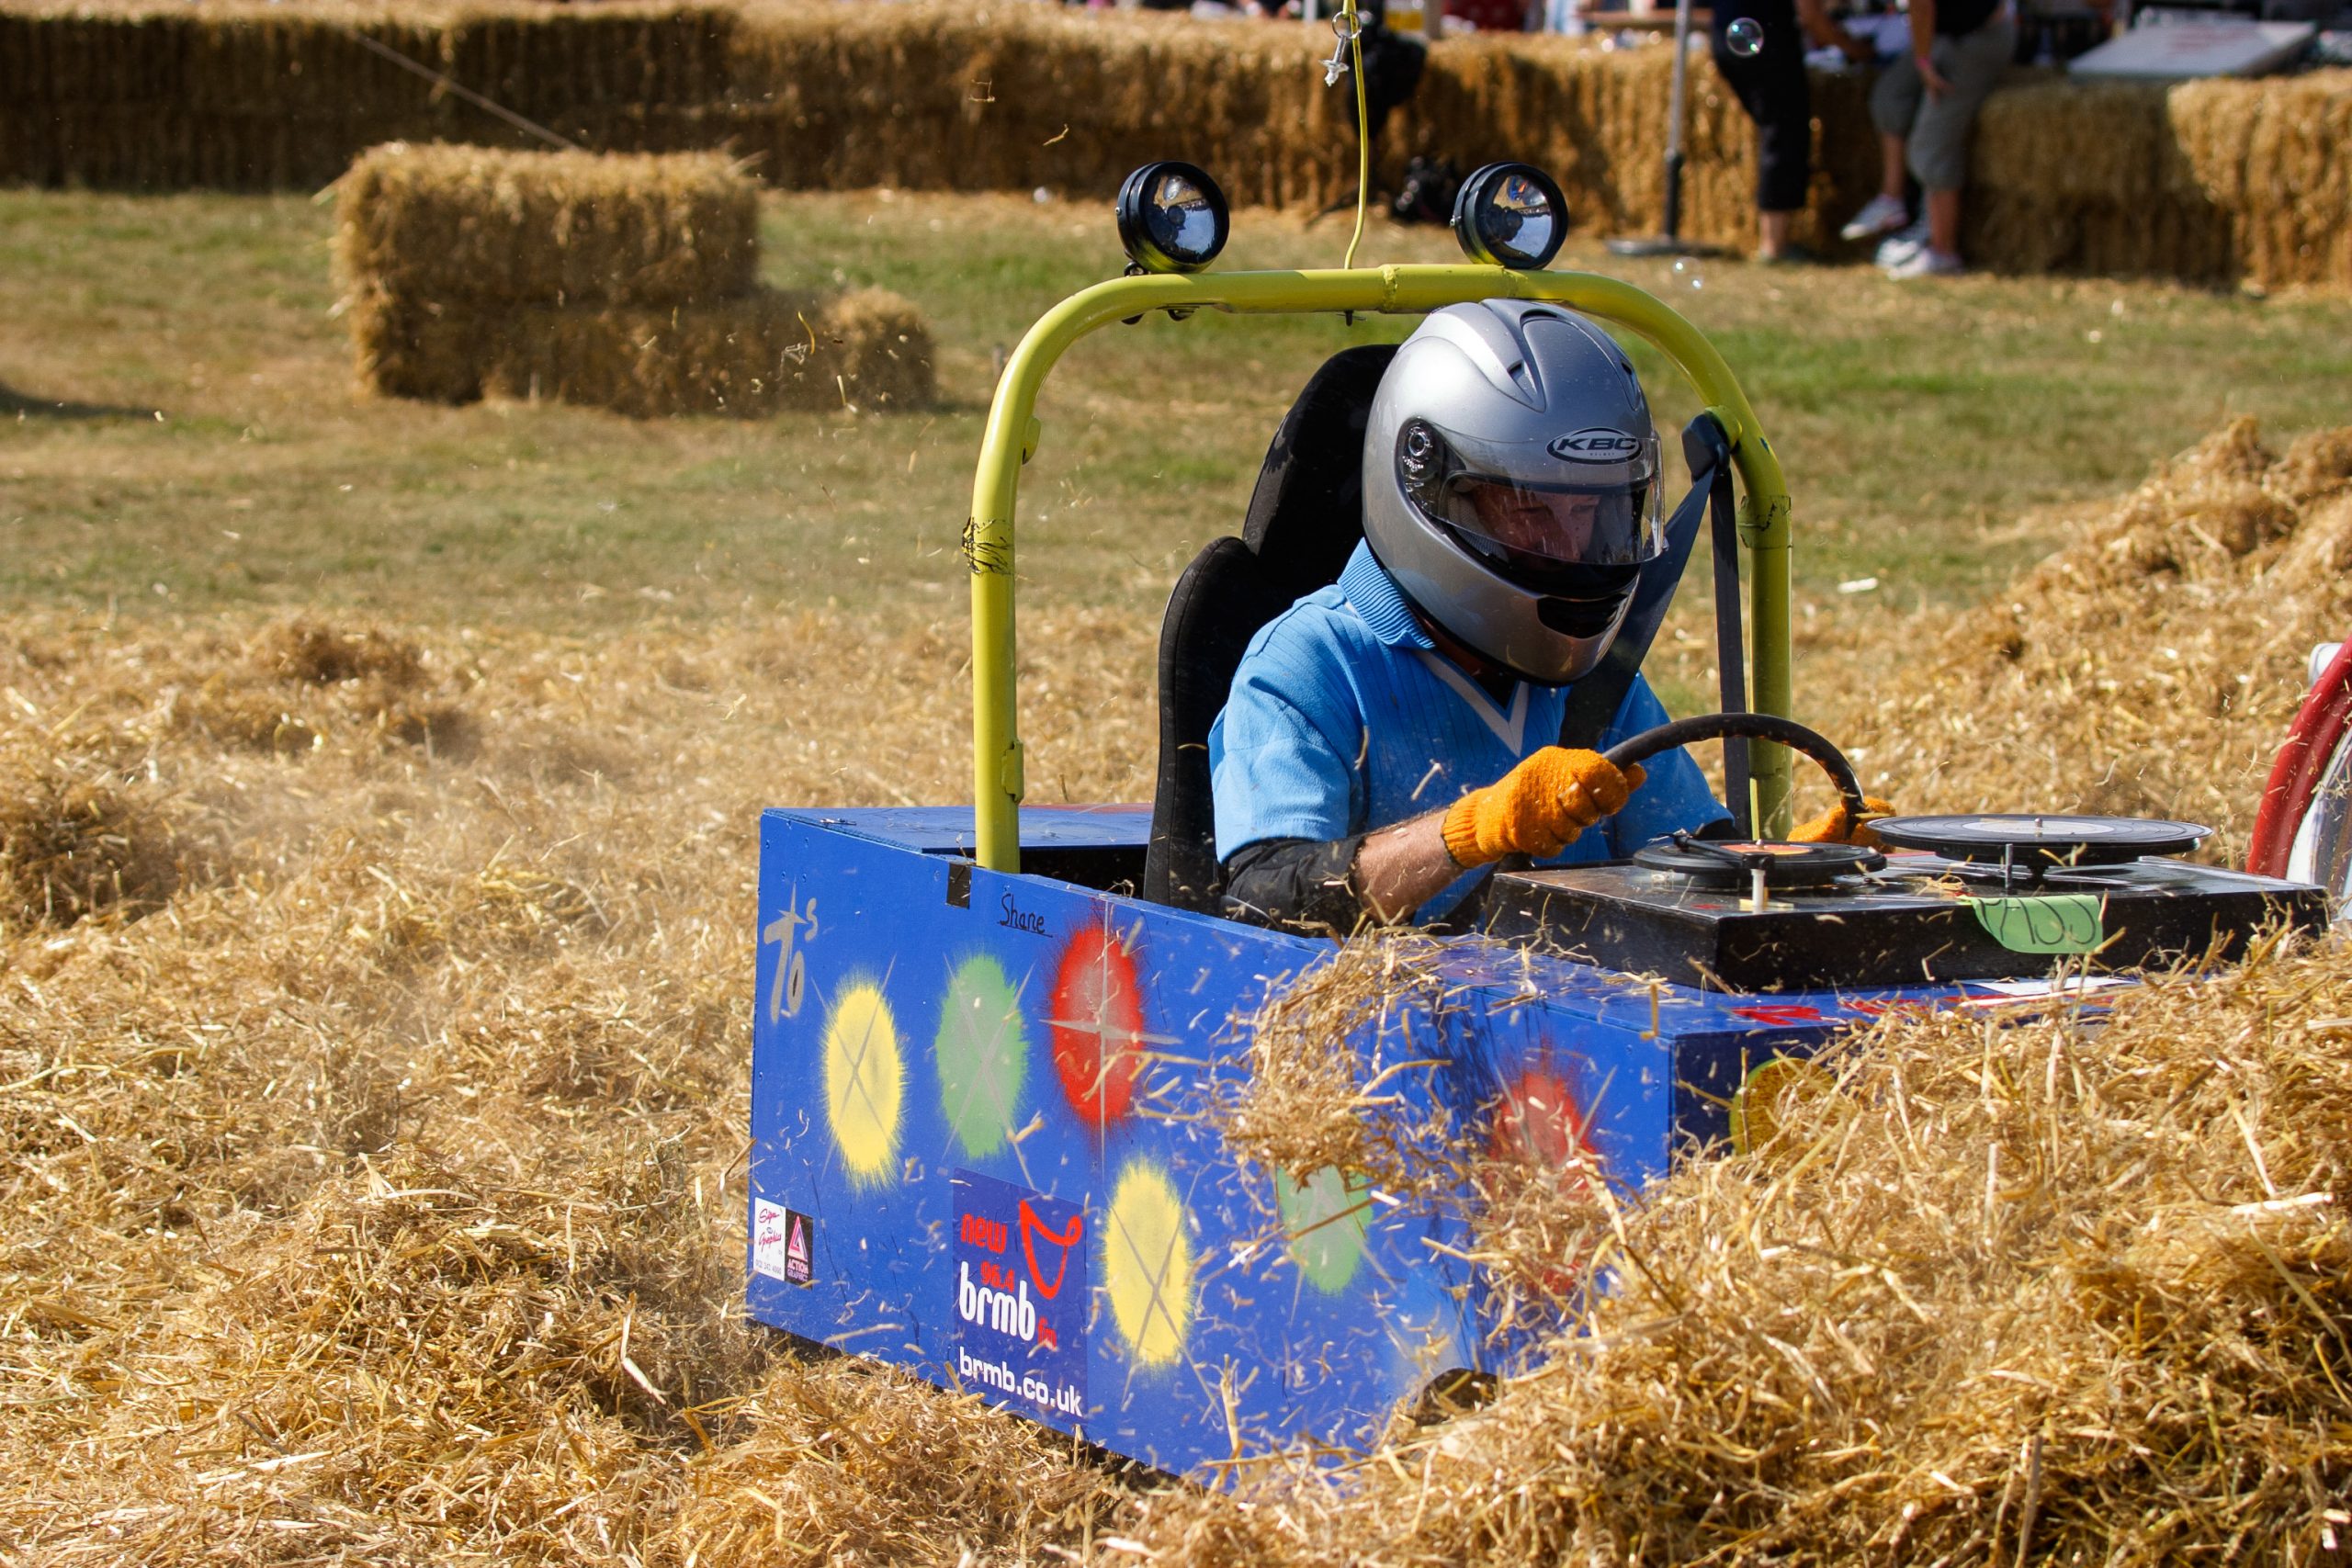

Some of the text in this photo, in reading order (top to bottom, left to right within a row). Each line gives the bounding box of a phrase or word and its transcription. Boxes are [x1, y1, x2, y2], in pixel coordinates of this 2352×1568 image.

[1556, 437, 1637, 450] KBC
[1000, 893, 1046, 934] Shane
[960, 1213, 1007, 1255] new
[980, 1260, 1015, 1293] 96.4
[959, 1261, 1036, 1341] brmb
[959, 1346, 1083, 1417] brmb.co.uk
